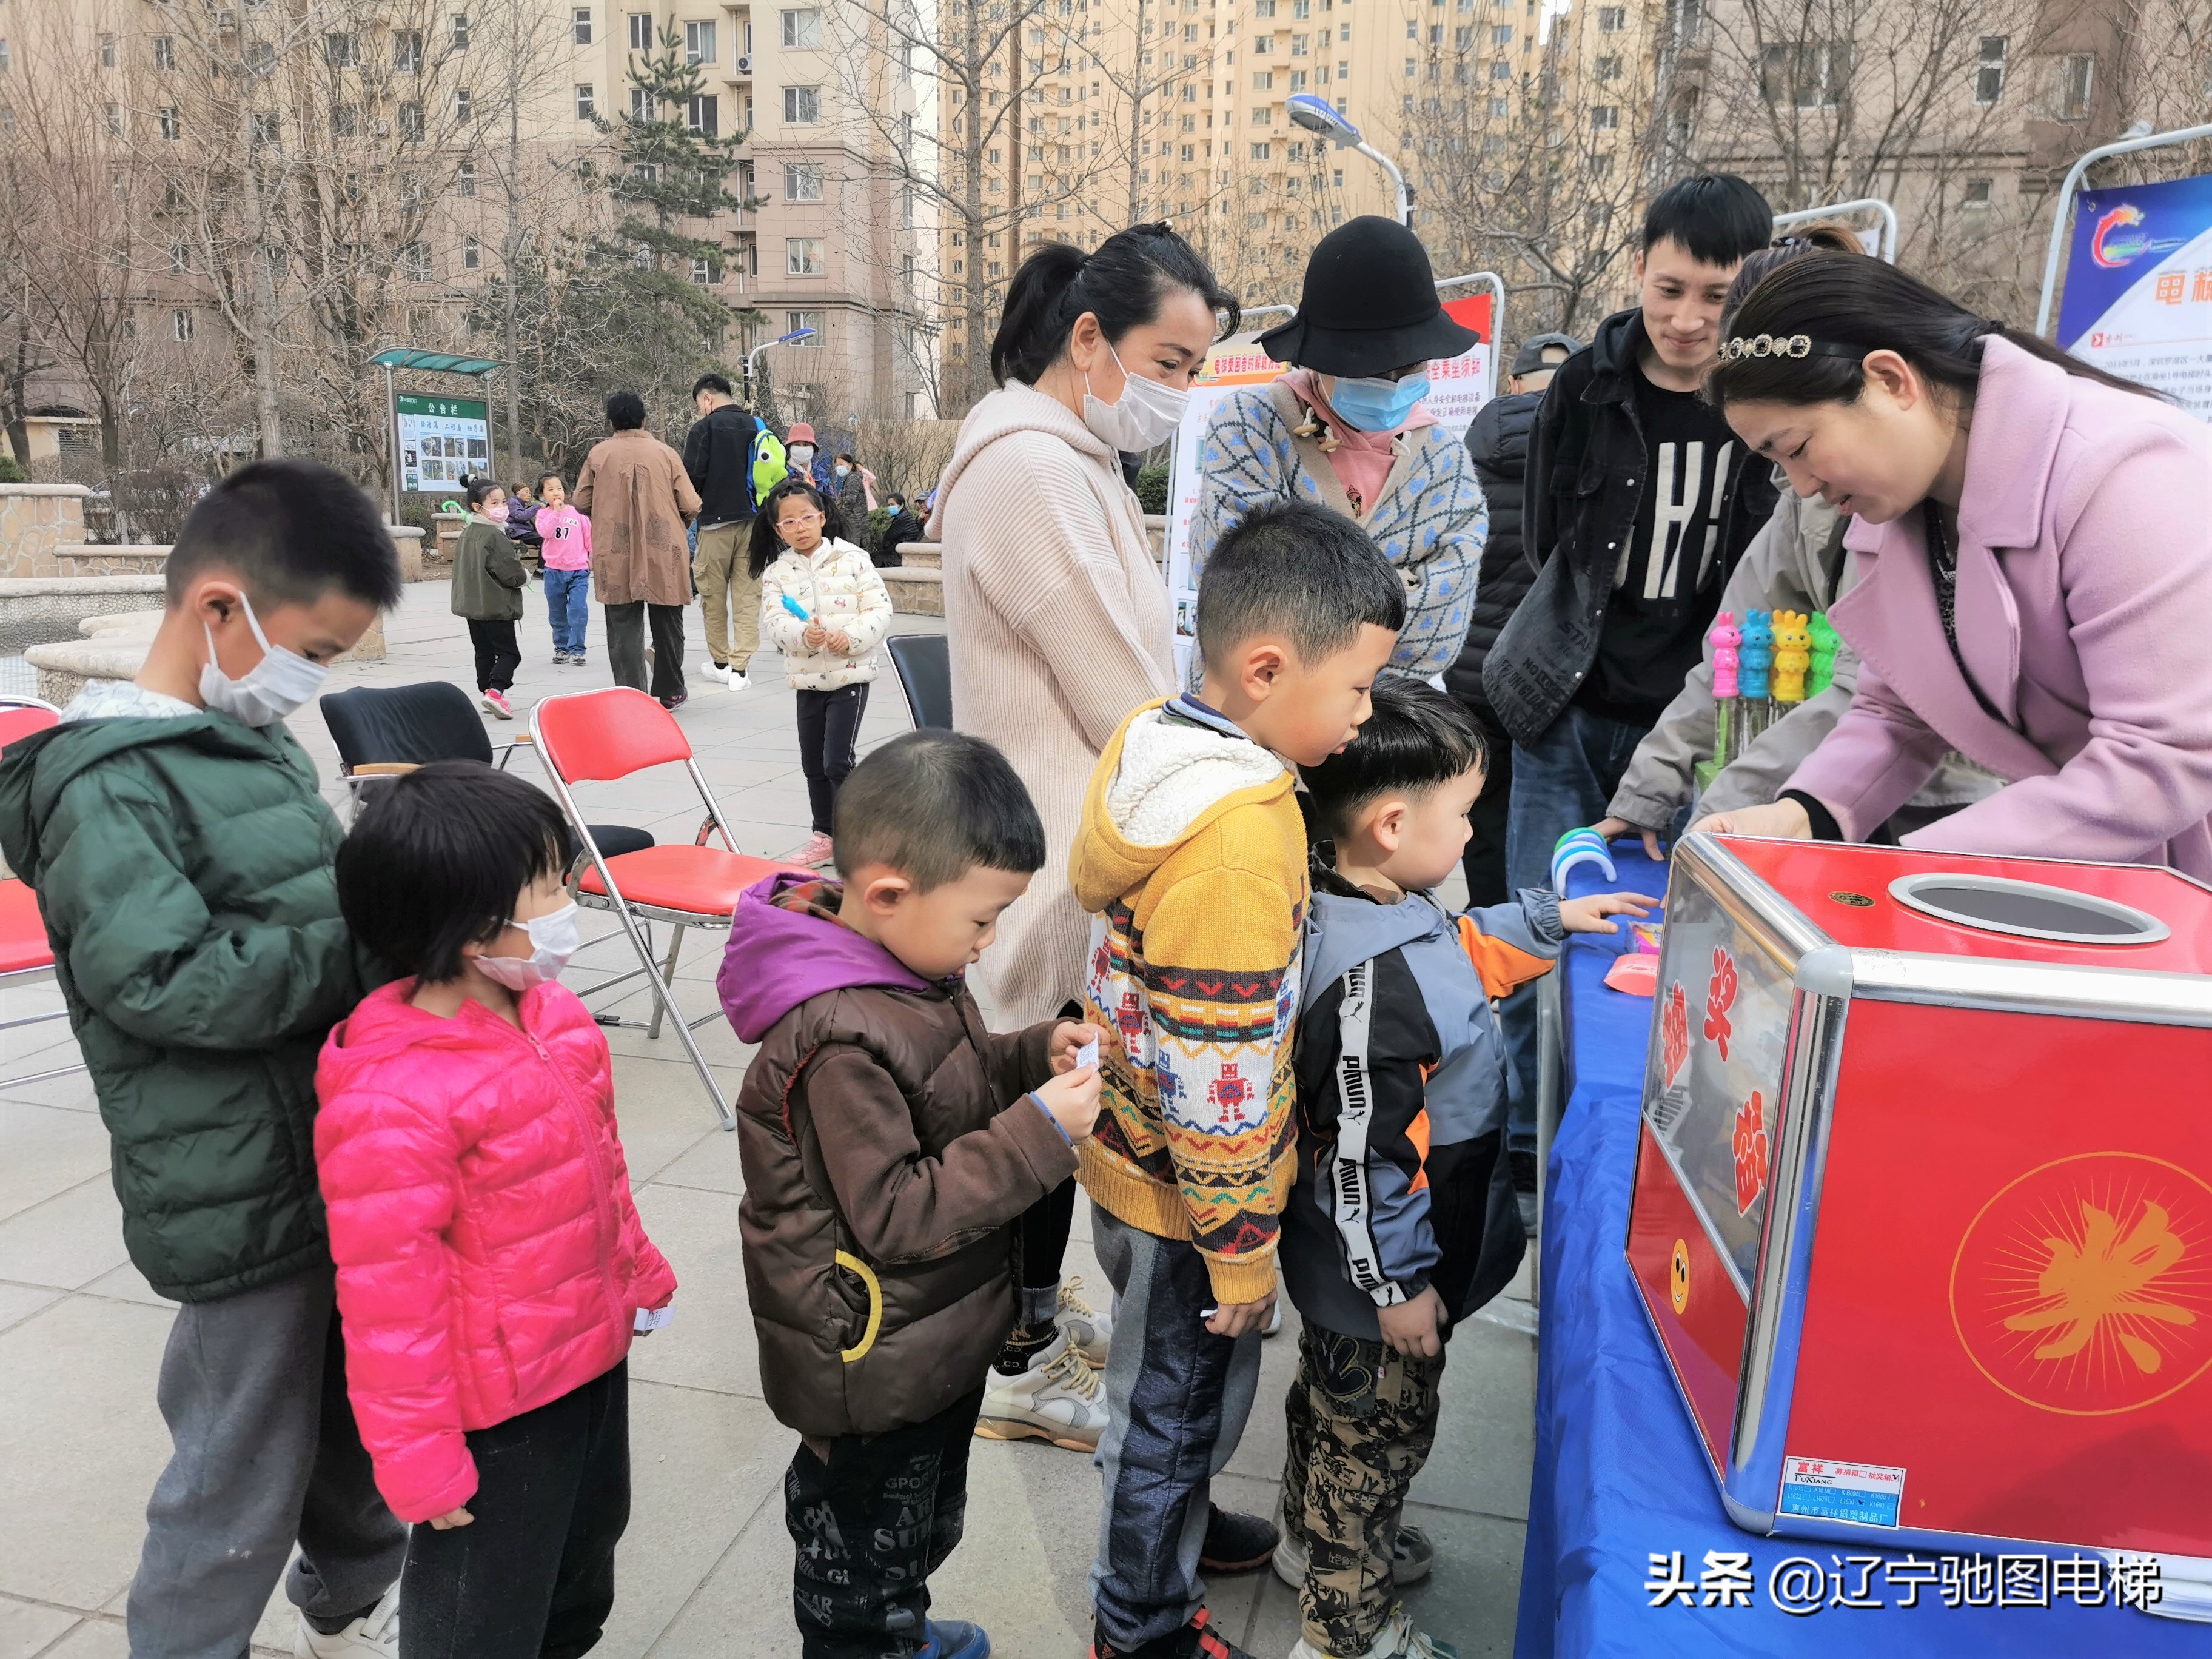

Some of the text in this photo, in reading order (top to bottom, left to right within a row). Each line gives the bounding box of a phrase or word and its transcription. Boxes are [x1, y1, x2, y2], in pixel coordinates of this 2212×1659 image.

[428, 402, 458, 415] 公告栏
[555, 527, 569, 538] 87
[1797, 1461, 1824, 1474] 富祥
[1835, 1467, 1891, 1481] 募捐箱 抽奖箱
[1795, 1475, 1832, 1485] FUXIANG
[1791, 1504, 1888, 1523] 惠州市富祥铝塑制品厂
